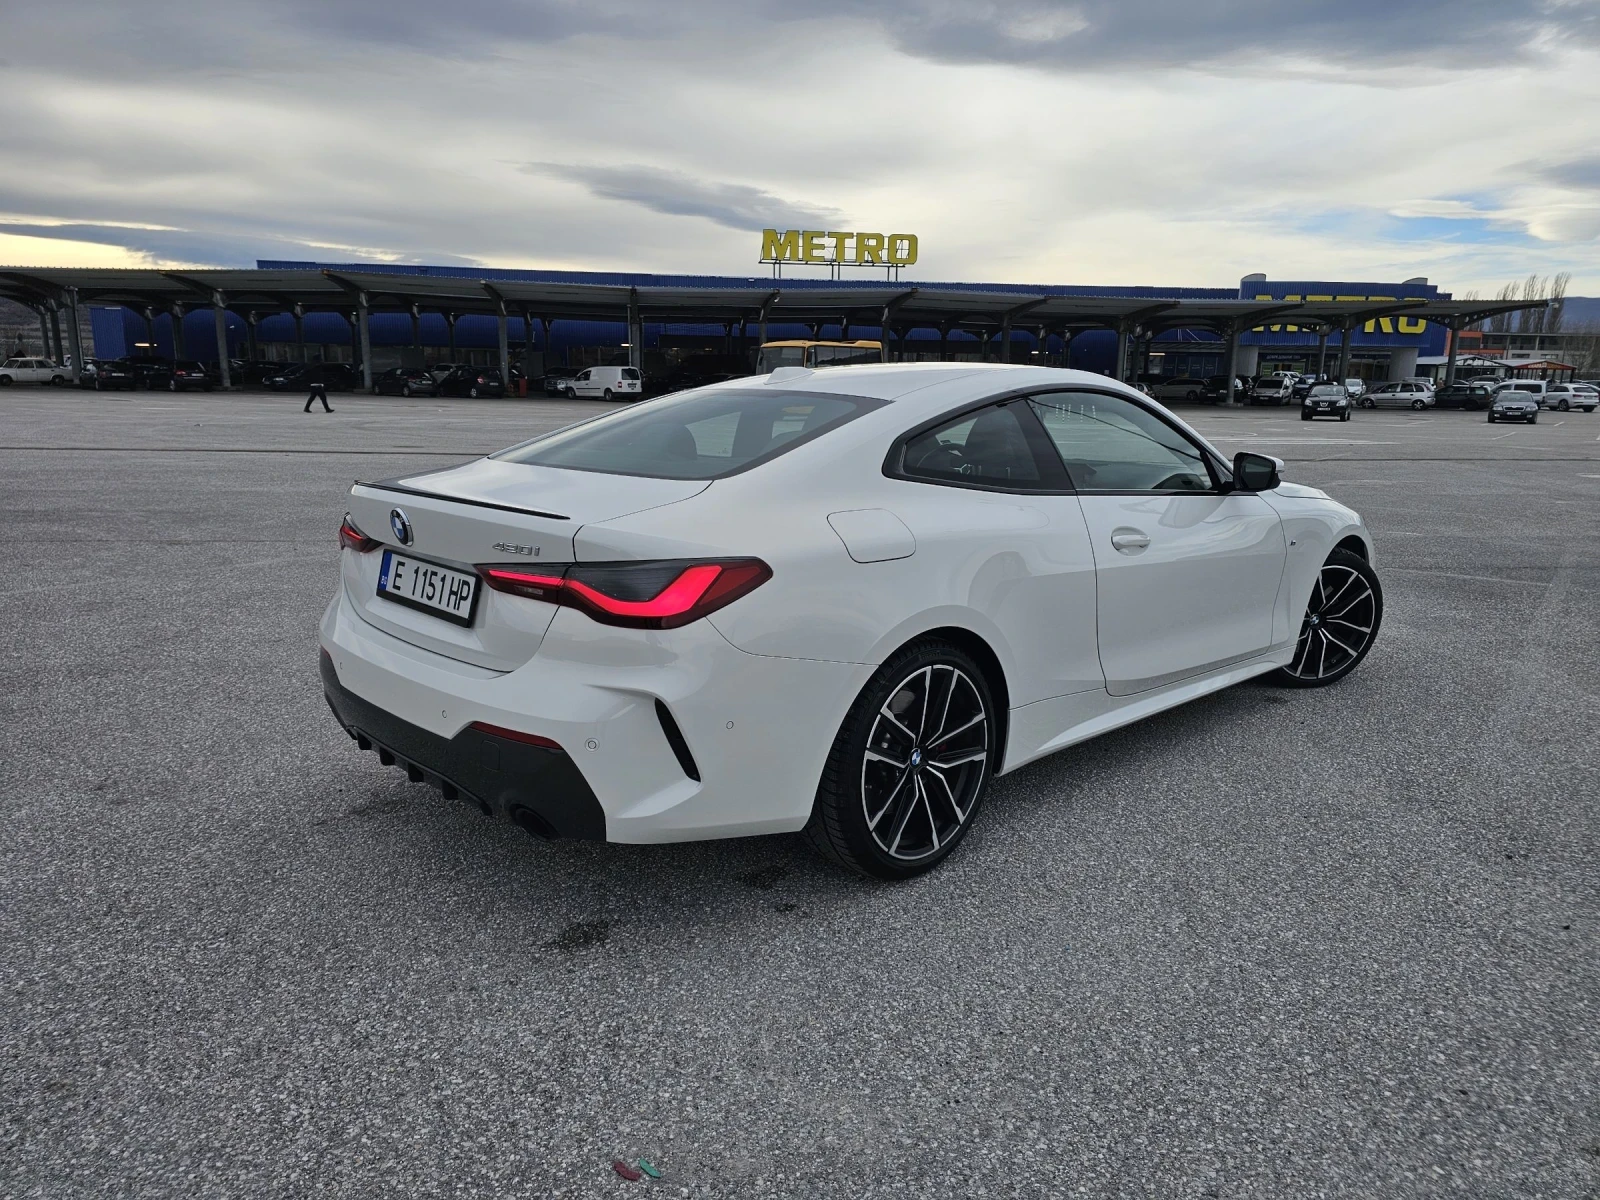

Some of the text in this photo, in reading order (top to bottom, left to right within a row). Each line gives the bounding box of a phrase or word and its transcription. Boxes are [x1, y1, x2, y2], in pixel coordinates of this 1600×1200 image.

[761, 228, 919, 266] METRO
[392, 560, 471, 611] E 1151 HP
